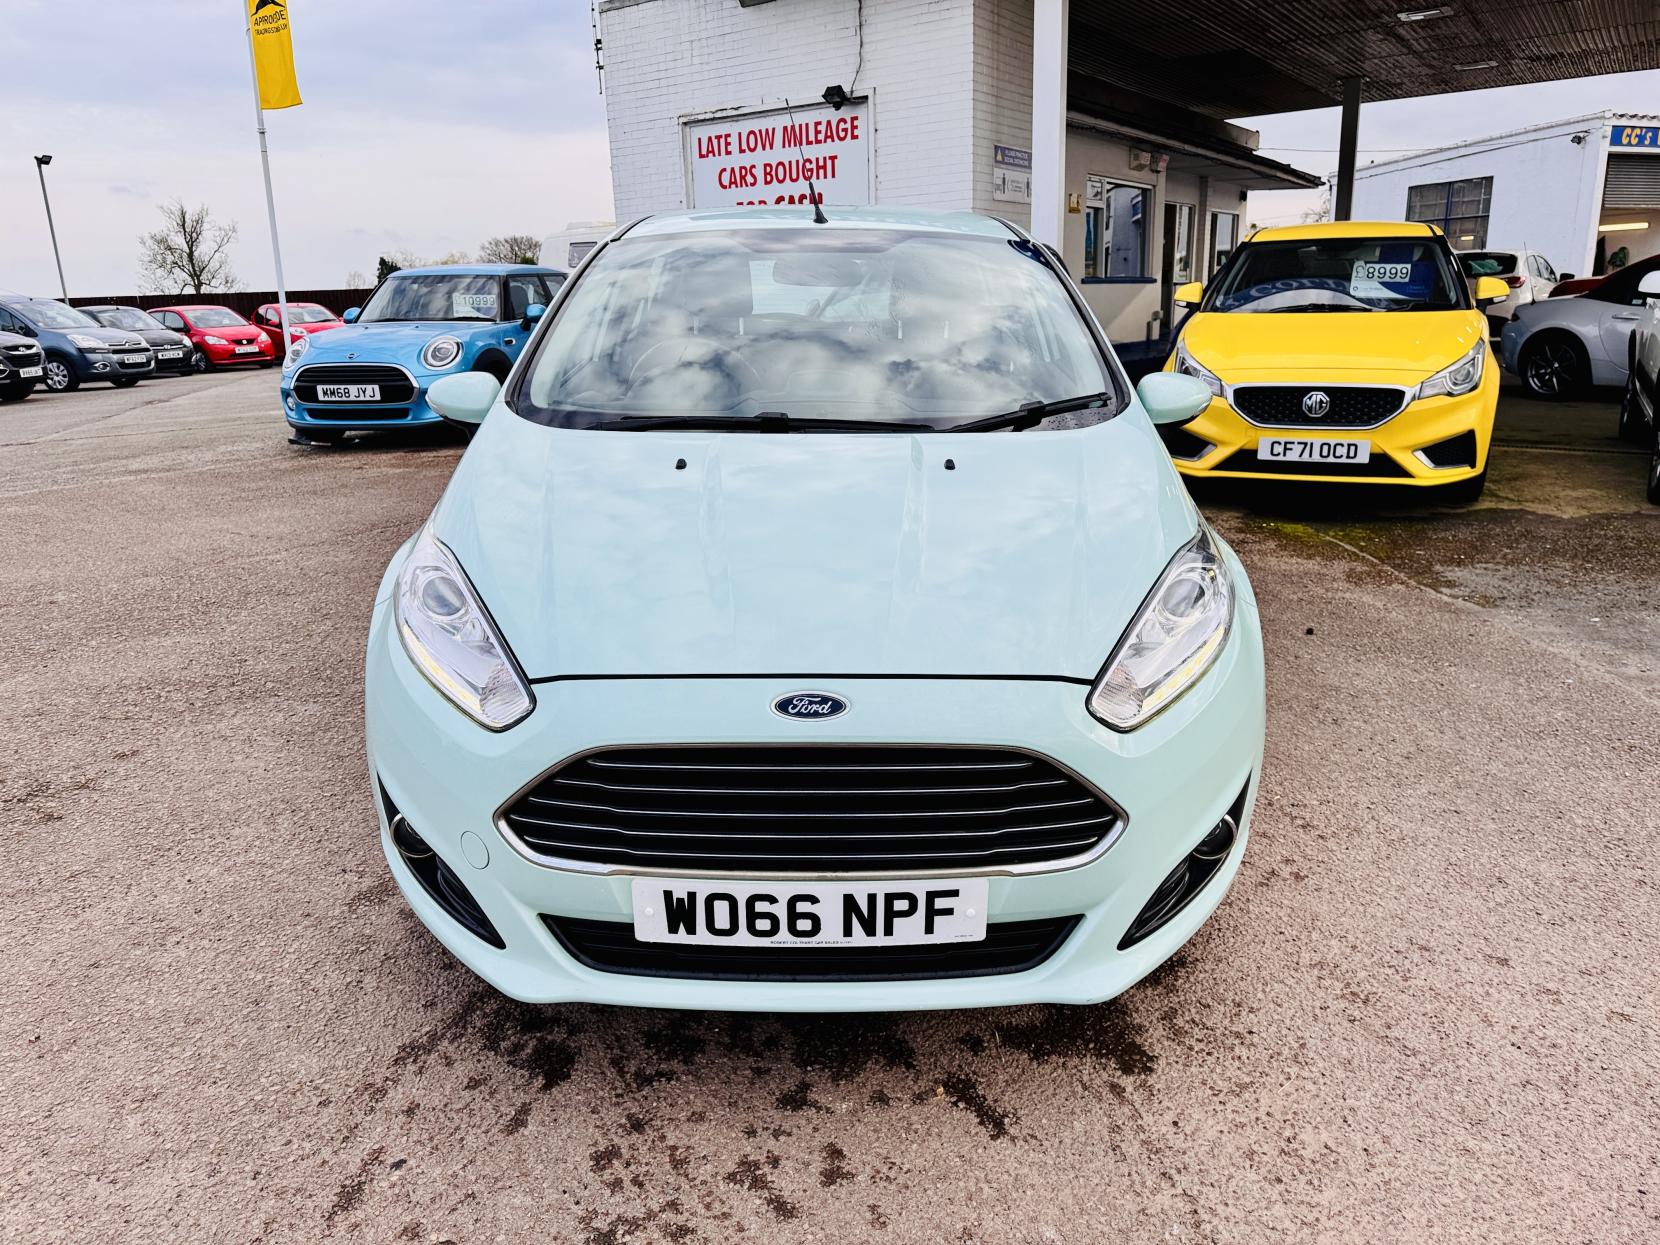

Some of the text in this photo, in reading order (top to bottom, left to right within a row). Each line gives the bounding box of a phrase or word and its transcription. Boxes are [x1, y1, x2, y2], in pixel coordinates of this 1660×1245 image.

[698, 116, 859, 159] LATE LOW MILEAGE
[1622, 128, 1652, 145] CC's
[718, 155, 838, 190] CARS BOUGHT
[322, 387, 376, 399] MM68 JYJ
[1305, 394, 1327, 415] MG
[1270, 441, 1358, 459] CF71 OCD
[788, 697, 832, 713] Ford
[663, 889, 960, 938] WO66 NPF
